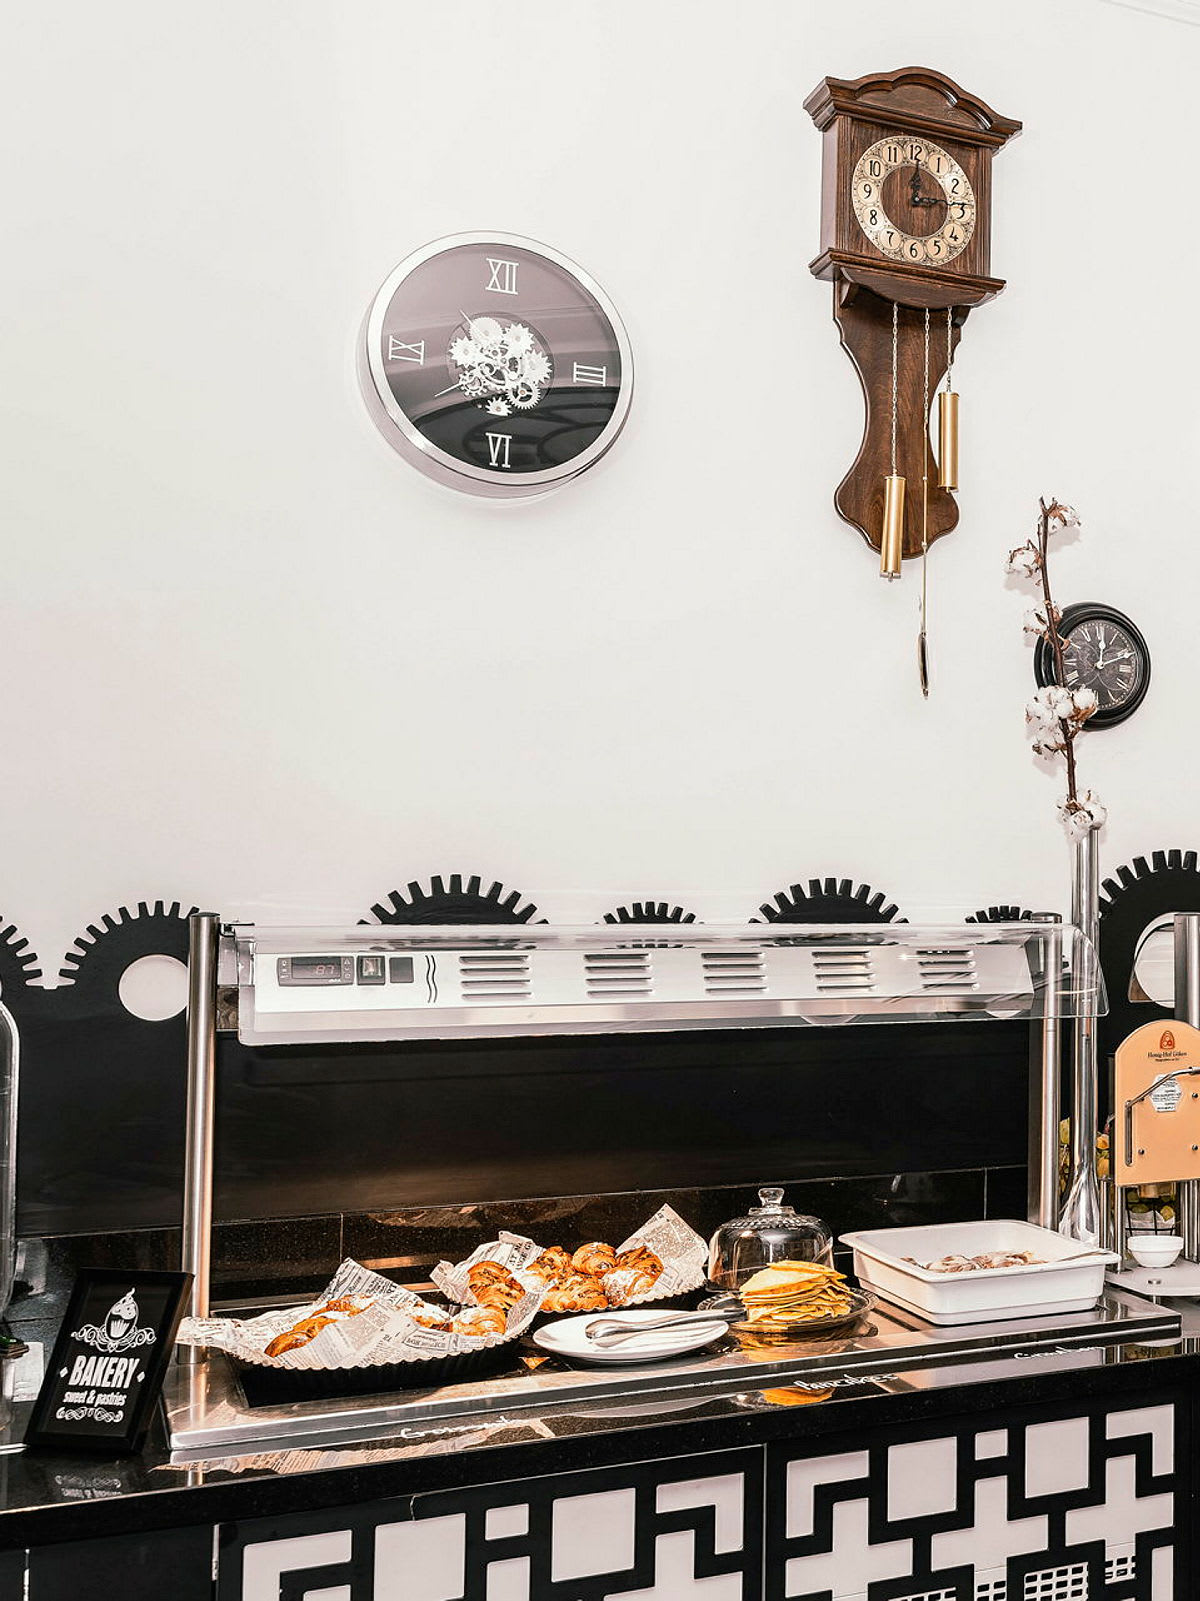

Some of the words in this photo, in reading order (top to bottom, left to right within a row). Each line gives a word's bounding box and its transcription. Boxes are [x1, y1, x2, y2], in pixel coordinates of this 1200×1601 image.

[888, 146, 897, 163] 11
[910, 144, 922, 161] 12
[869, 160, 881, 177] 10
[936, 157, 941, 173] 1
[863, 183, 872, 199] 9
[951, 178, 959, 195] 2
[869, 209, 878, 226] 8
[886, 231, 894, 247] 7
[950, 226, 959, 242] 4
[909, 242, 919, 258] 6
[933, 240, 941, 256] 5
[485, 257, 519, 295] XII
[388, 335, 425, 366] IX
[572, 361, 606, 387] III
[485, 432, 512, 468] VI
[68, 1354, 140, 1389] BAKERY
